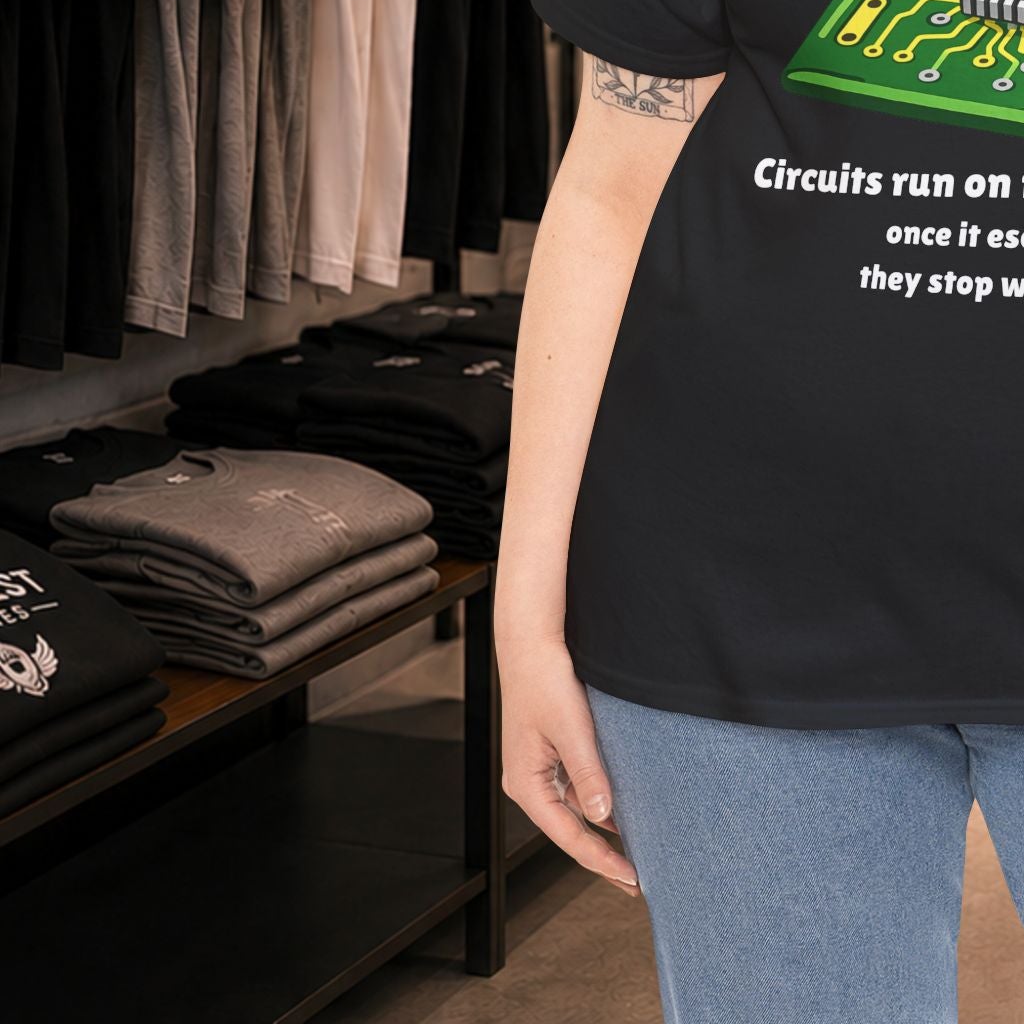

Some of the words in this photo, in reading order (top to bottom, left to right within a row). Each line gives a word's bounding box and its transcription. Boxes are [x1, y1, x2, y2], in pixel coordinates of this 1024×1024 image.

[614, 91, 636, 109] THE
[639, 100, 660, 115] SUN
[754, 157, 883, 195] Circuits
[892, 172, 954, 197] run
[964, 173, 1011, 198] on
[886, 223, 951, 246] once
[959, 221, 981, 247] it
[860, 264, 922, 298] they
[928, 271, 993, 302] stop
[0, 568, 45, 602] ST
[0, 603, 31, 627] ES
